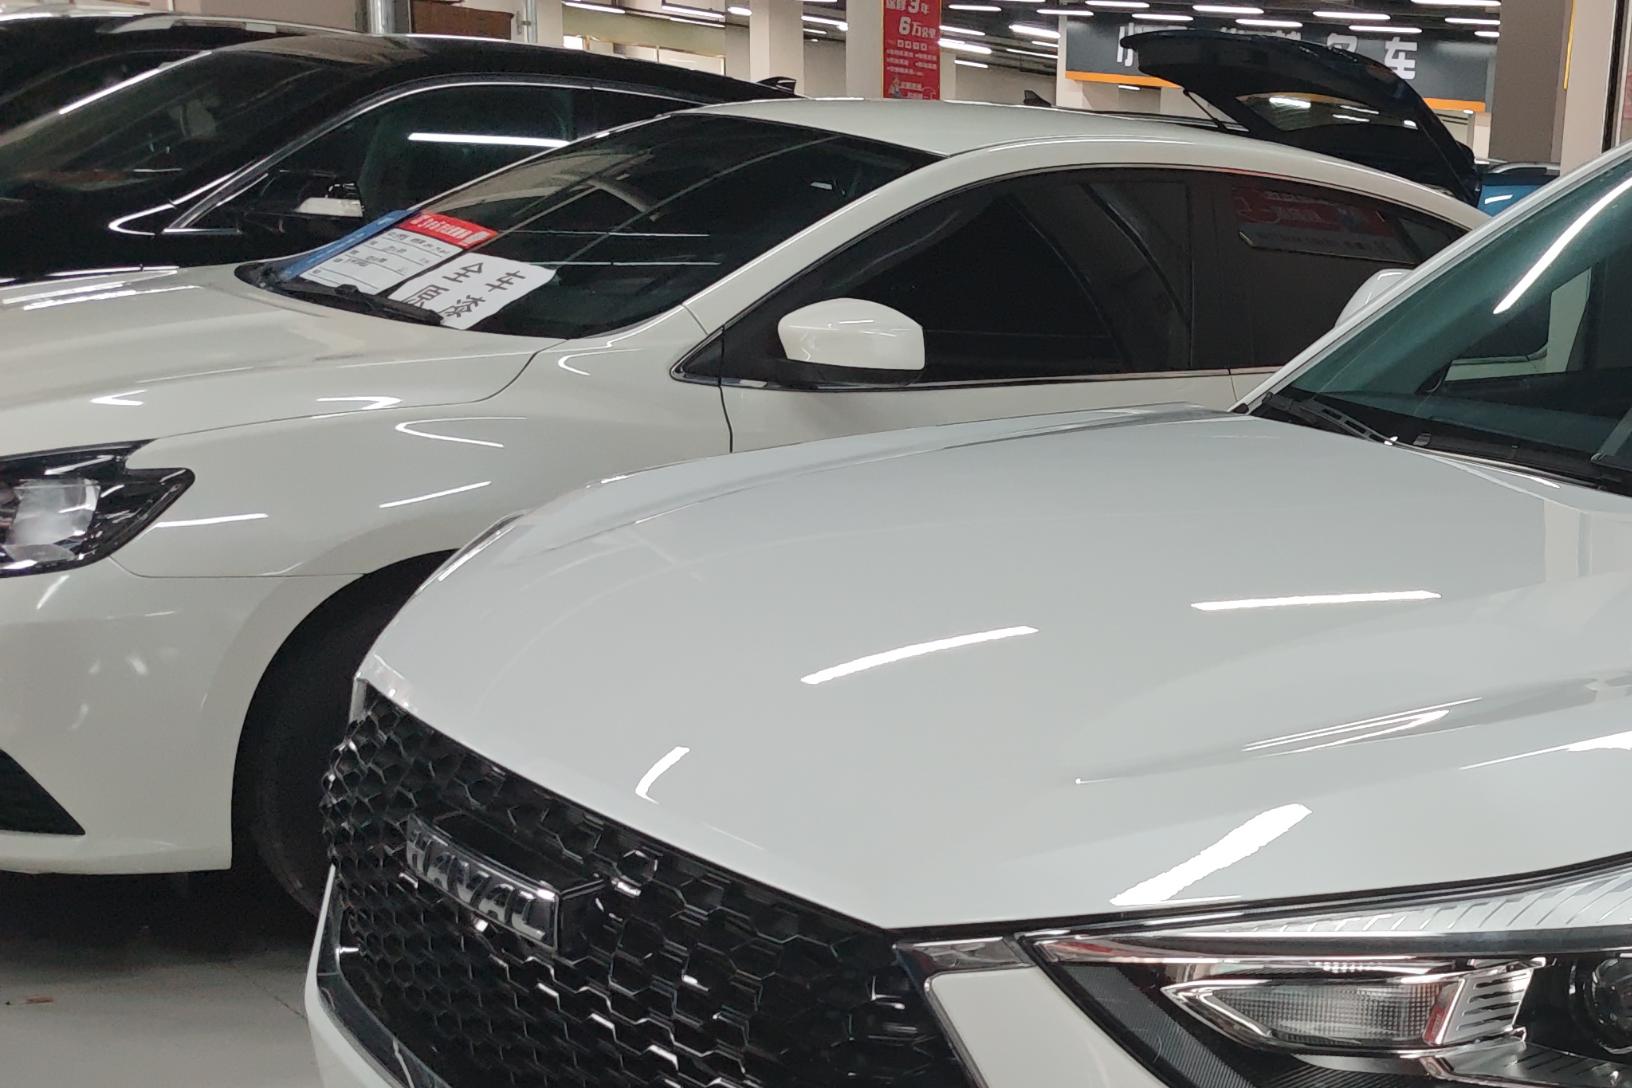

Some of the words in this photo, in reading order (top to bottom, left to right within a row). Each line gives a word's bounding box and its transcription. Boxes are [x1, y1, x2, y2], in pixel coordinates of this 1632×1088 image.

[898, 16, 937, 39] 6万公里
[407, 829, 546, 941] HAVAL
